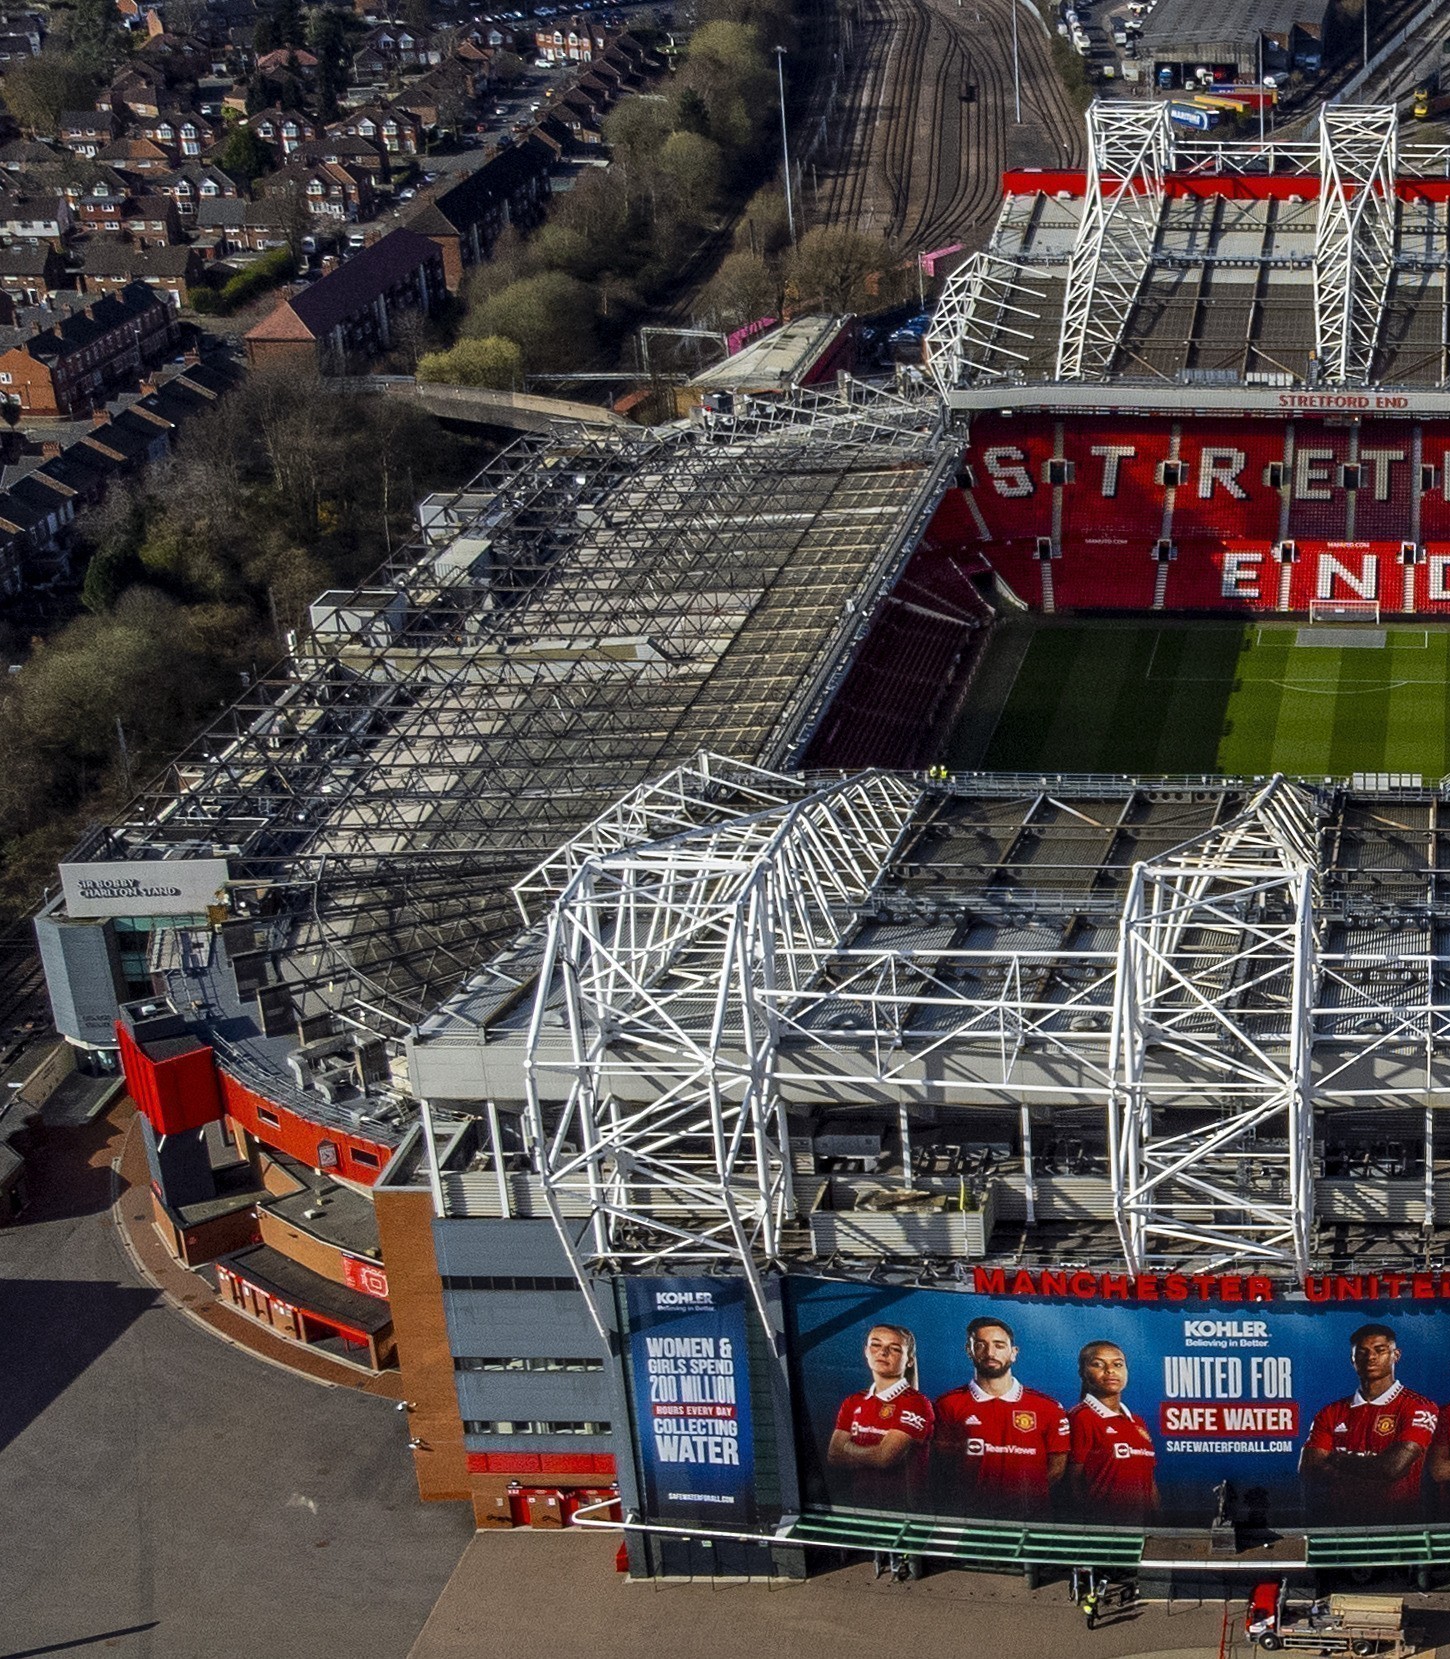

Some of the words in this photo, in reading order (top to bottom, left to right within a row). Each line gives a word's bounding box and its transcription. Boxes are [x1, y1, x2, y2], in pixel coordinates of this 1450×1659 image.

[1279, 394, 1369, 409] STRETFORD
[1375, 396, 1408, 409] END
[78, 879, 93, 889] SIR
[973, 1266, 1272, 1301] MANCHESTER
[656, 1292, 713, 1304] KOHLER
[1184, 1321, 1268, 1337] KOHLER
[646, 1338, 714, 1358] WOMEN
[719, 1338, 732, 1358] &
[1185, 1339, 1227, 1348] Believing
[1229, 1339, 1238, 1347] in
[648, 1359, 687, 1374] GIRLS
[690, 1359, 734, 1375] SPEND
[1164, 1356, 1243, 1398] UNITED
[1251, 1357, 1292, 1398] FOR
[649, 1375, 678, 1403] 200
[680, 1375, 736, 1404] MILLION
[656, 1406, 684, 1415] HOURS
[686, 1406, 714, 1415] EVERY
[716, 1407, 732, 1416] DAY
[653, 1418, 738, 1437] COLLECTING
[1166, 1408, 1218, 1431] SAFE
[1223, 1408, 1293, 1431] WATER
[655, 1435, 740, 1465] WATER
[985, 1443, 1036, 1455] TeamViewer
[1166, 1441, 1293, 1453] SAFEWATERFORALL.COM
